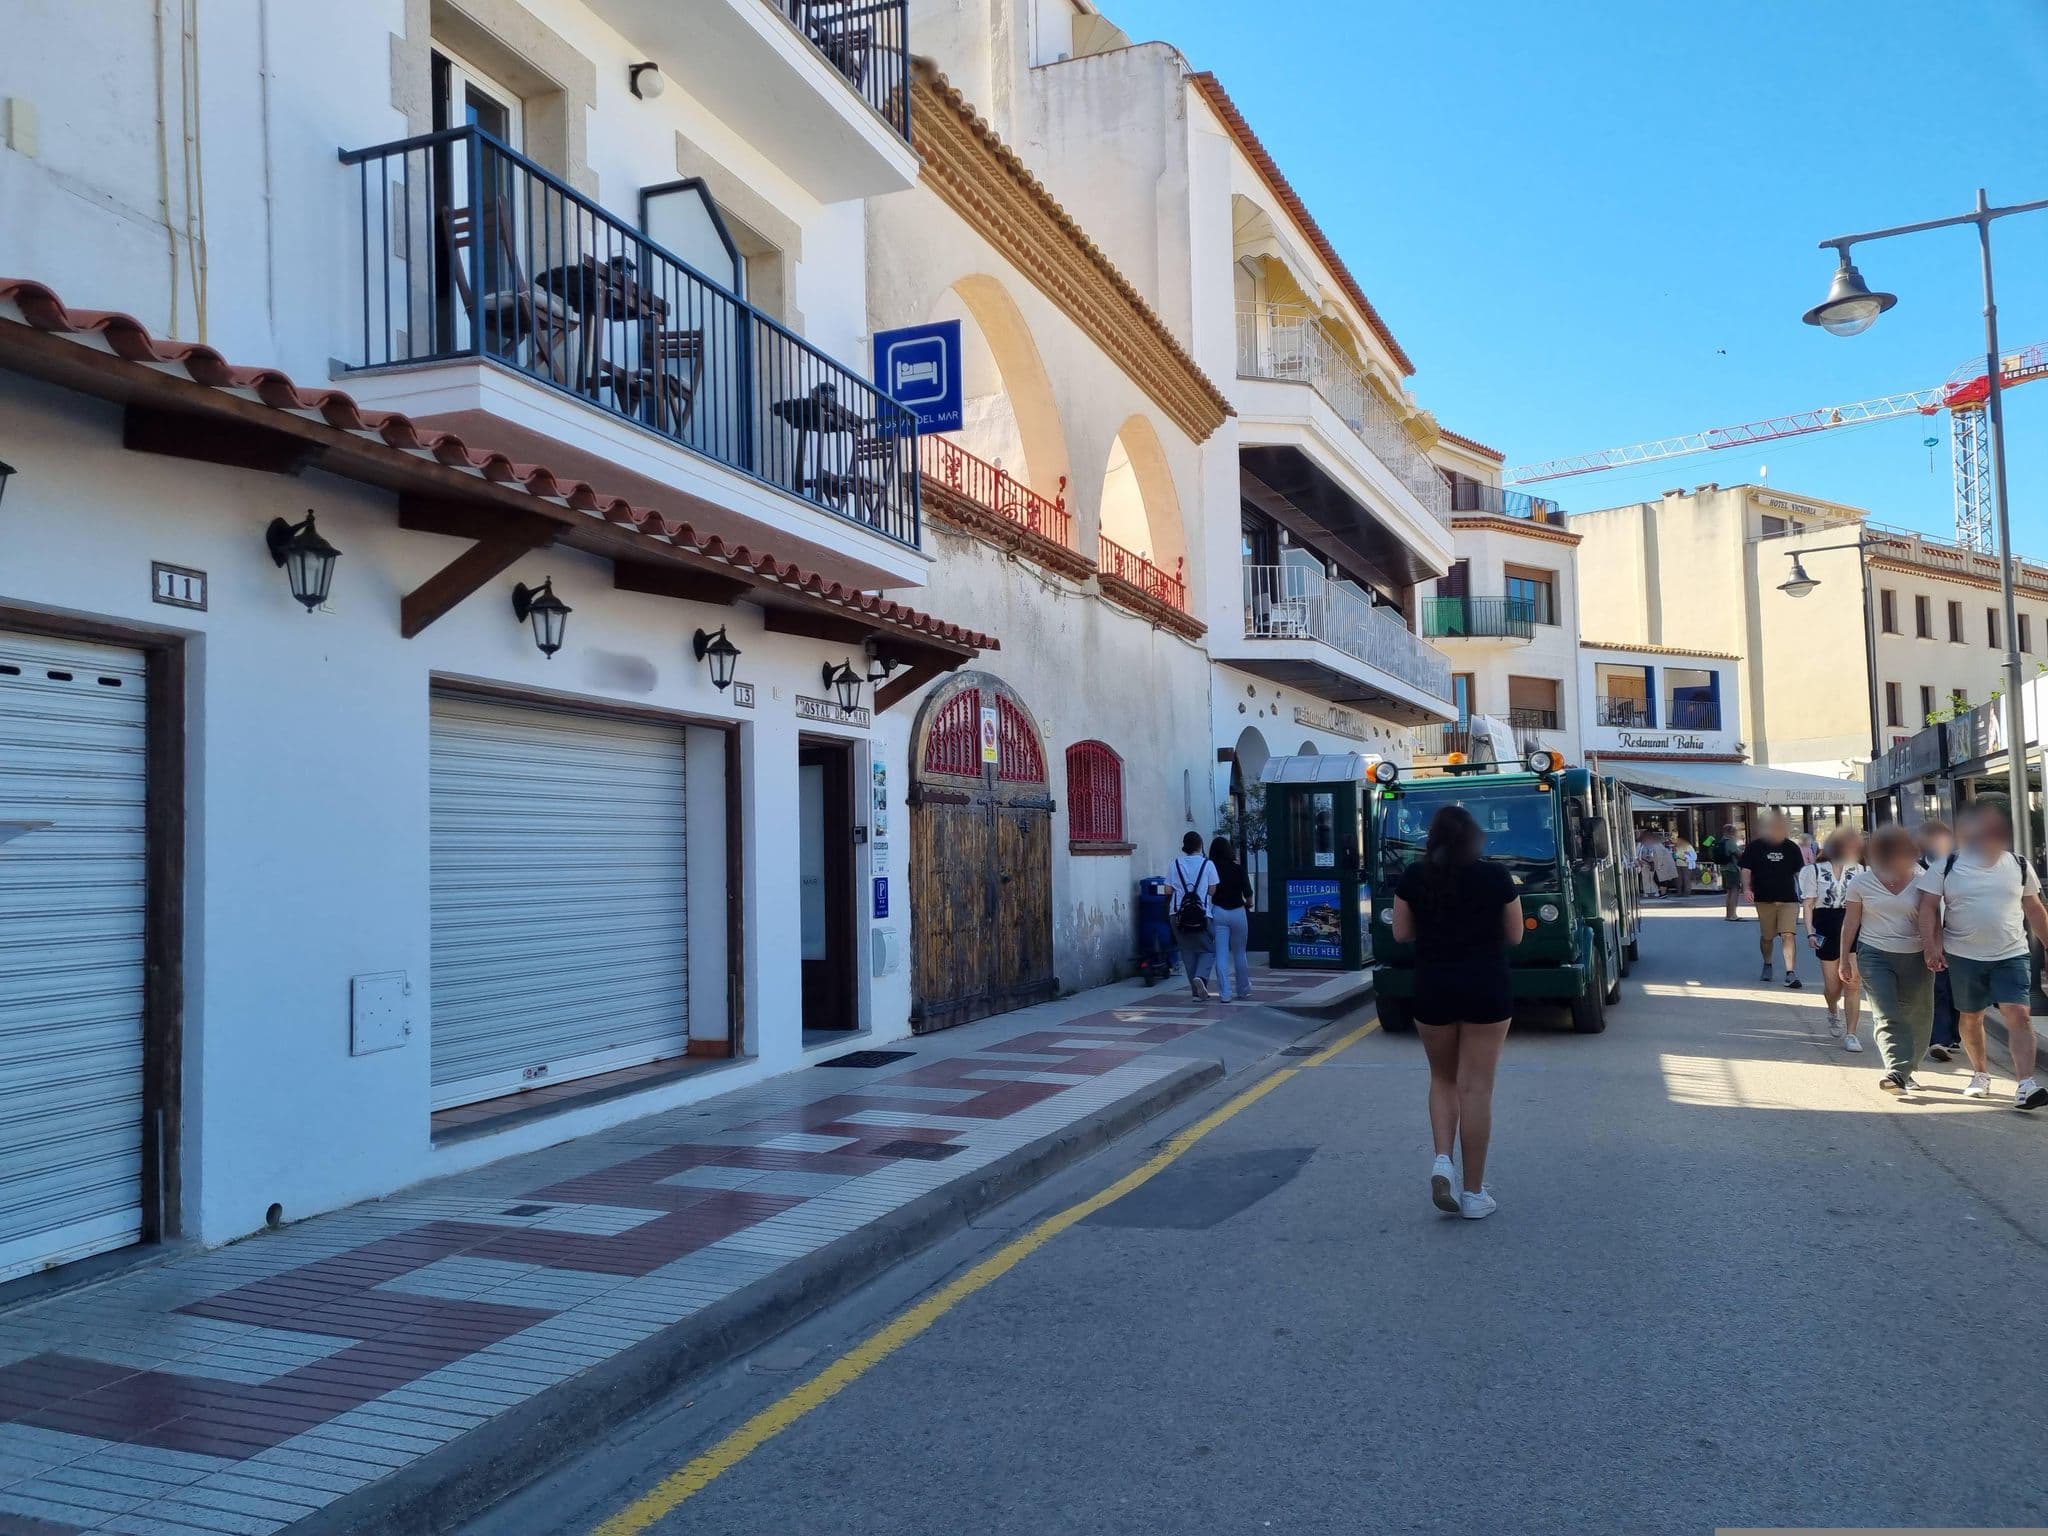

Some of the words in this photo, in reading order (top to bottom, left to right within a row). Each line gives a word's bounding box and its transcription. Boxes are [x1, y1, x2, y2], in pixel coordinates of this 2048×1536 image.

[917, 414, 934, 425] DEL
[938, 410, 959, 421] MAR
[1769, 498, 1788, 509] HOTEL
[167, 574, 192, 600] 11
[739, 688, 751, 703] 13
[835, 708, 849, 721] DEL
[853, 711, 868, 724] MAR
[1618, 733, 1669, 748] Restaurant
[1289, 885, 1317, 893] BITLLETS
[1290, 946, 1318, 955] TICKETS
[1321, 947, 1340, 956] HERE
